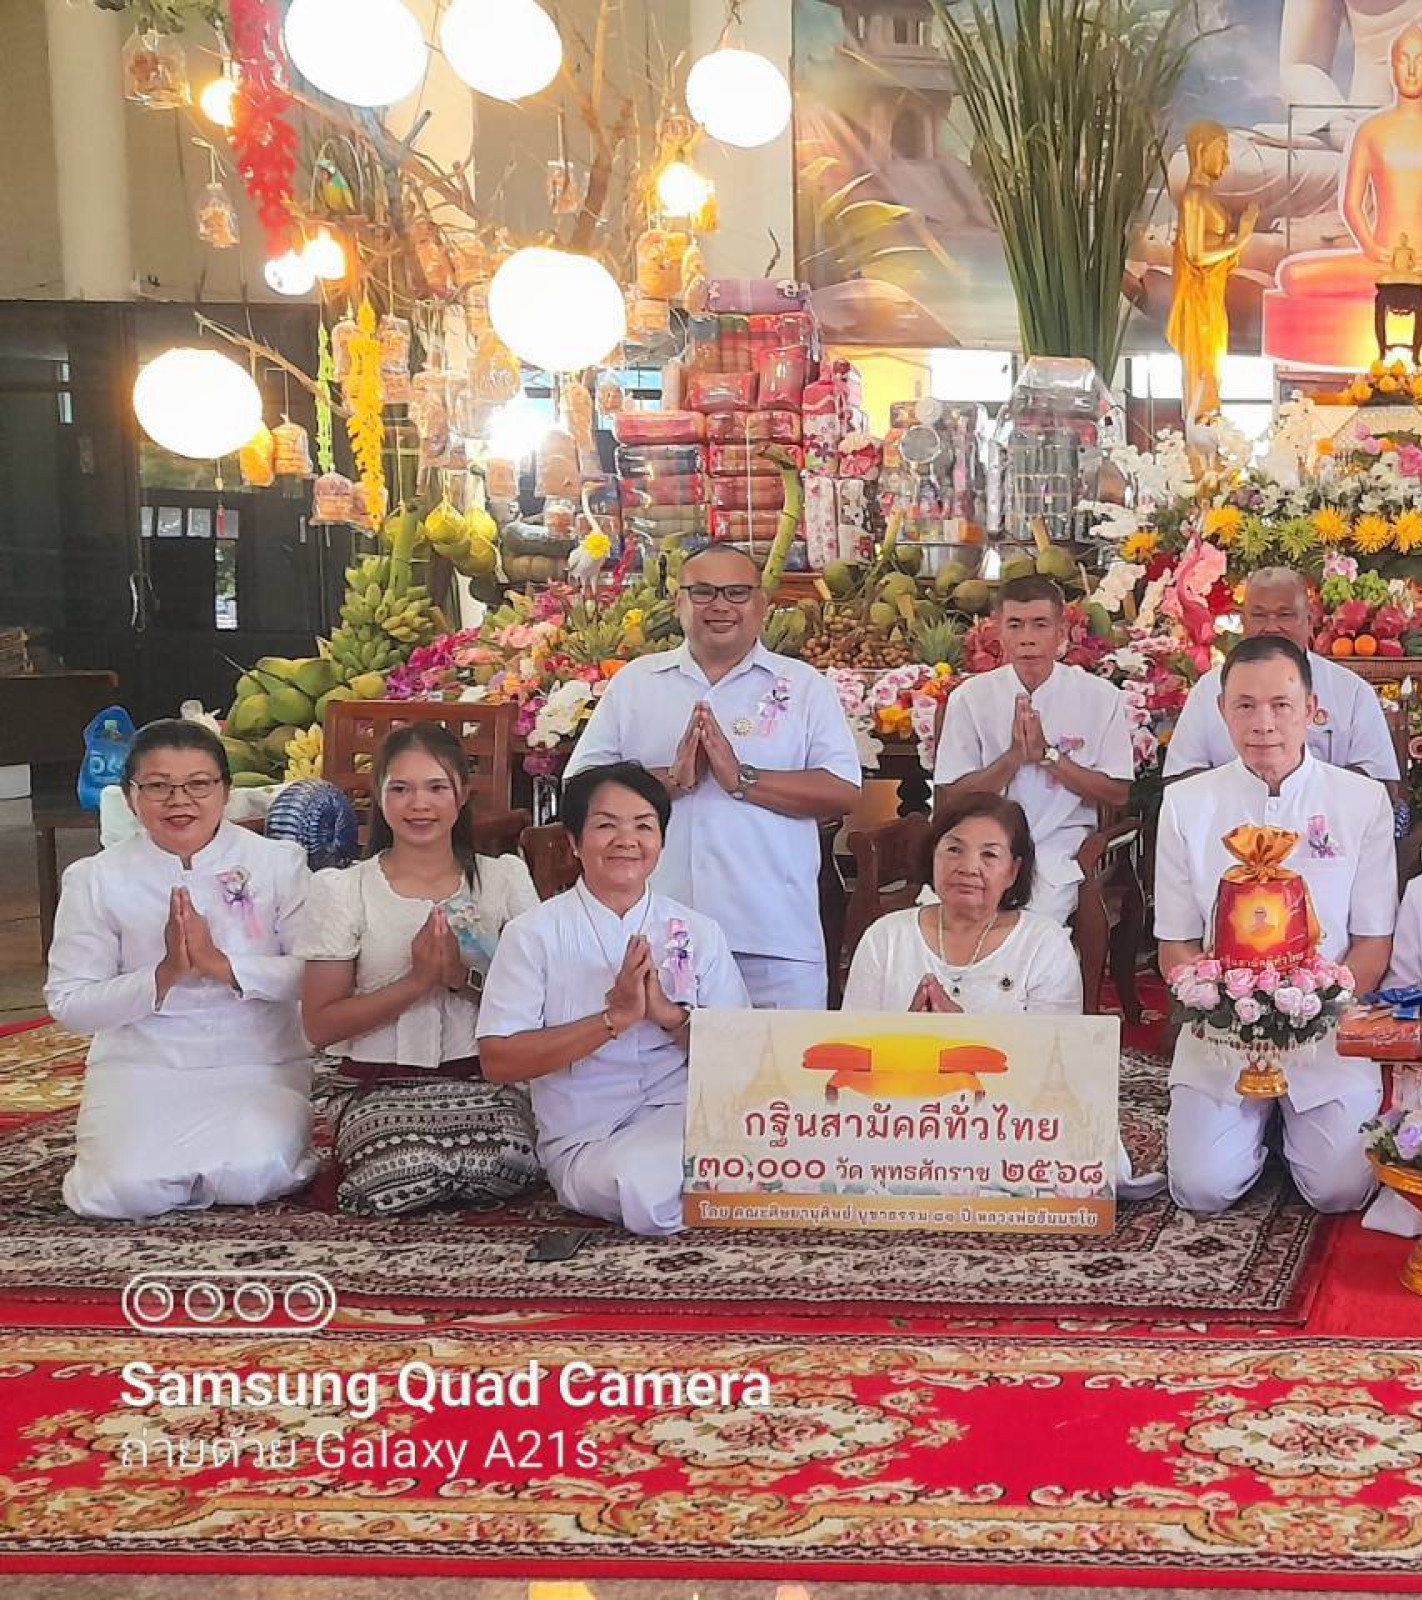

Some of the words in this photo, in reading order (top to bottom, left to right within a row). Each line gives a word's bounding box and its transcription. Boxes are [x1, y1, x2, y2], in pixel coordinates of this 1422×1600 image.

[745, 1094, 1060, 1148] กฐินสามัคคีทั่วไทย
[698, 1156, 826, 1182] ๓๐,๐๐๐
[835, 1156, 863, 1180] วัด
[871, 1157, 990, 1188] พุทธศักราช
[1001, 1158, 1104, 1185] ๒๕๖๘
[700, 1201, 727, 1219] โดย
[960, 1205, 972, 1224] ปี
